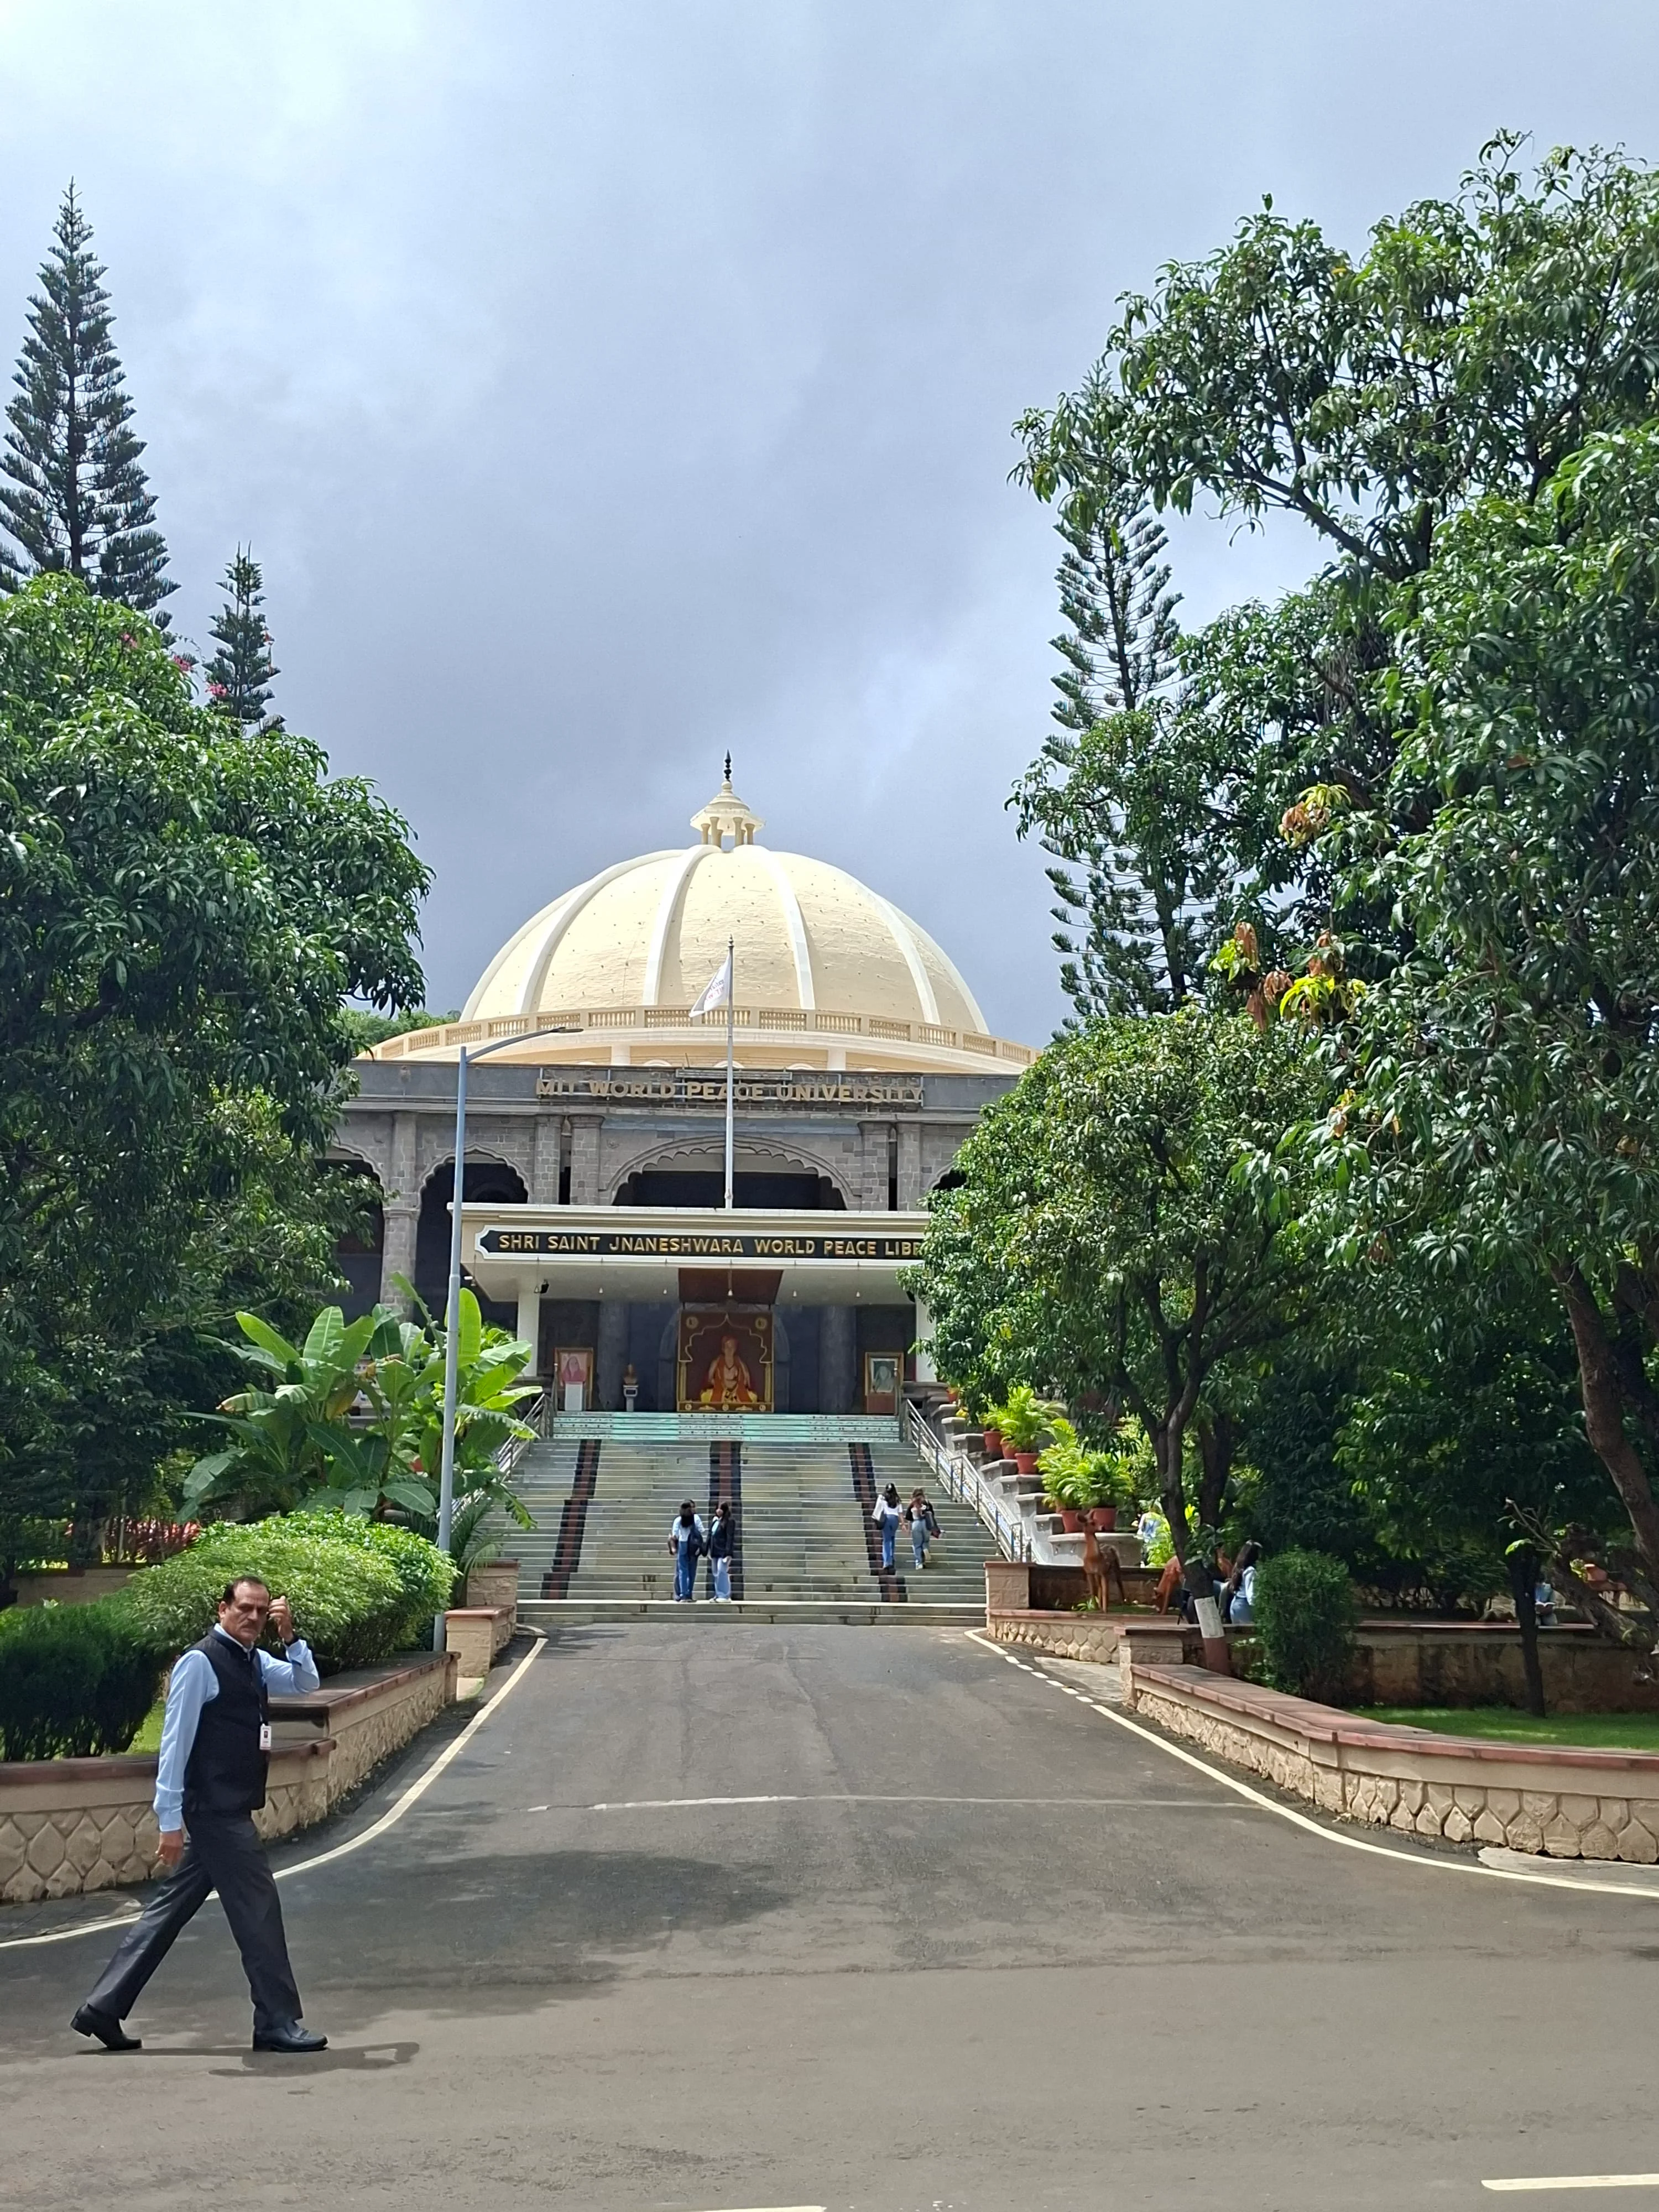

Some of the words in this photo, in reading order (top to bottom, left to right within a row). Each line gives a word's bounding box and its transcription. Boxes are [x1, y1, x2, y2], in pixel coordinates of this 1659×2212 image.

[536, 1079, 576, 1095] MIT
[588, 1079, 676, 1098] WORLD
[687, 1082, 765, 1100] PEACE
[775, 1083, 923, 1103] UNIVERSITY
[499, 1234, 540, 1249] SHRI
[547, 1235, 601, 1251] SAINT
[609, 1237, 744, 1253] JNANESHWARA
[754, 1239, 815, 1254] WORLD
[823, 1240, 877, 1255] PEACE
[885, 1241, 922, 1256] LIBR
